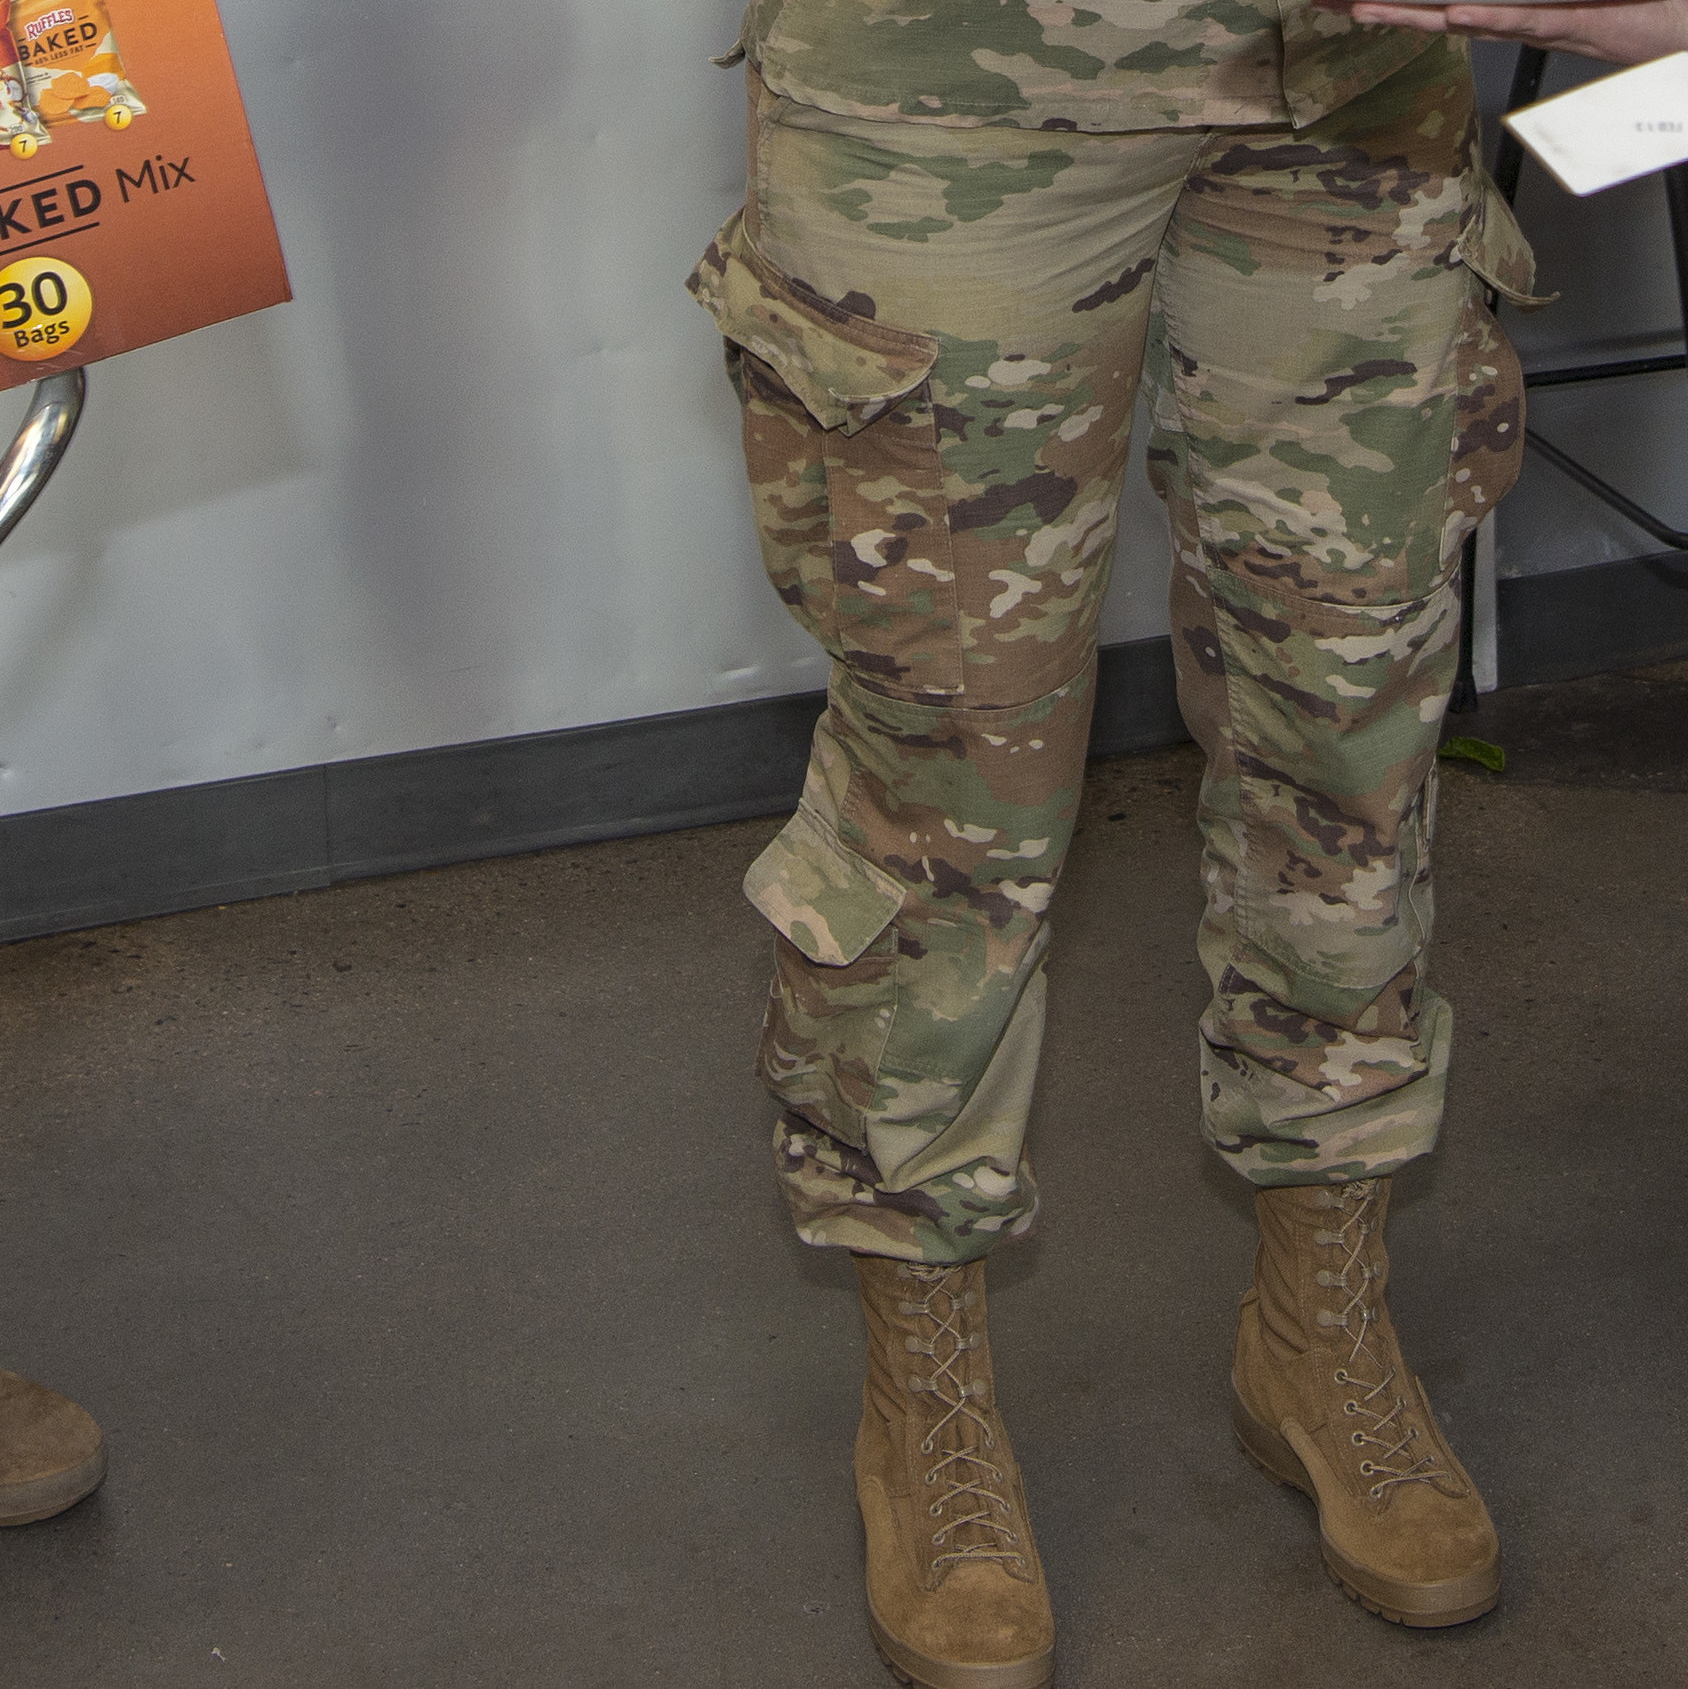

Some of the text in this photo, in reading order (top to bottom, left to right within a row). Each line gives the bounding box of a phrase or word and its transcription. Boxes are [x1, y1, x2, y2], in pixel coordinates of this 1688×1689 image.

[25, 10, 73, 40] RUFFLES
[17, 22, 98, 61] BAKED
[51, 44, 85, 61] LESS FAT
[114, 111, 121, 124] 7
[19, 140, 27, 153] 7
[115, 154, 196, 204] Mix
[13, 320, 71, 348] Bags
